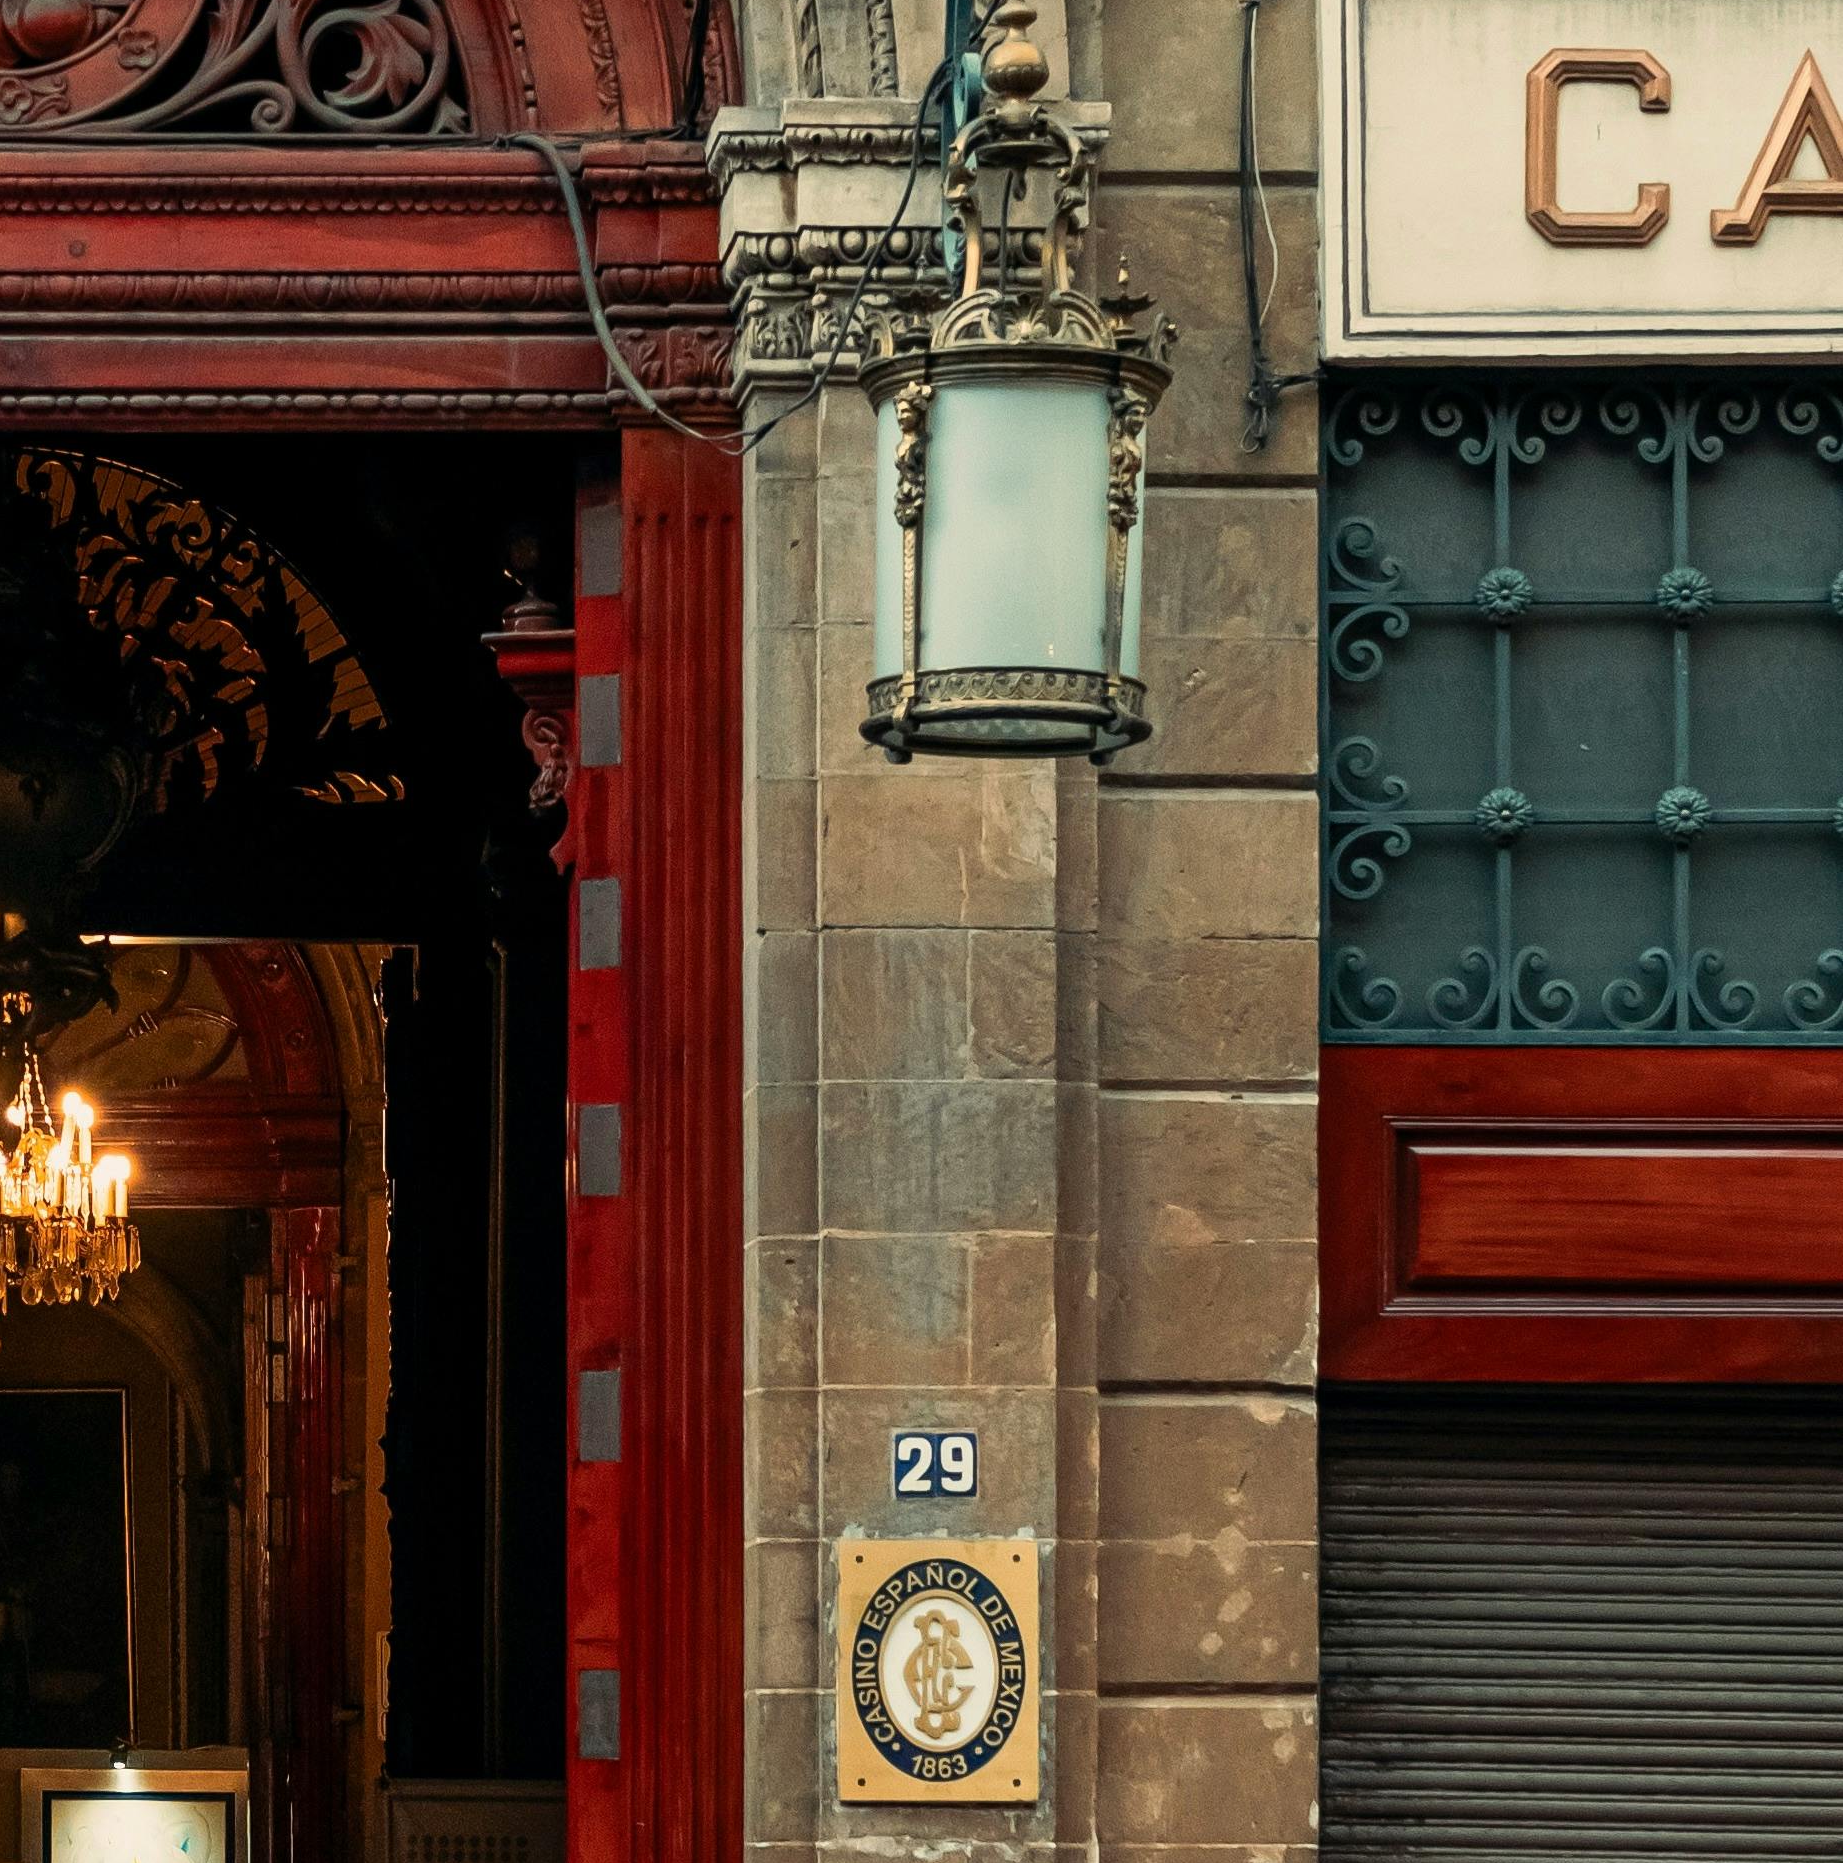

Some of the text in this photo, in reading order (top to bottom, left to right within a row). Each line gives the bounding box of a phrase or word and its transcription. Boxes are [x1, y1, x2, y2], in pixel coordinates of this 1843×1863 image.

[1525, 48, 1843, 247] CA
[898, 1436, 975, 1493] 29
[855, 1561, 1023, 1748] CASINO ESPAÑOL DE MEXICO
[912, 1754, 968, 1779] 1863
